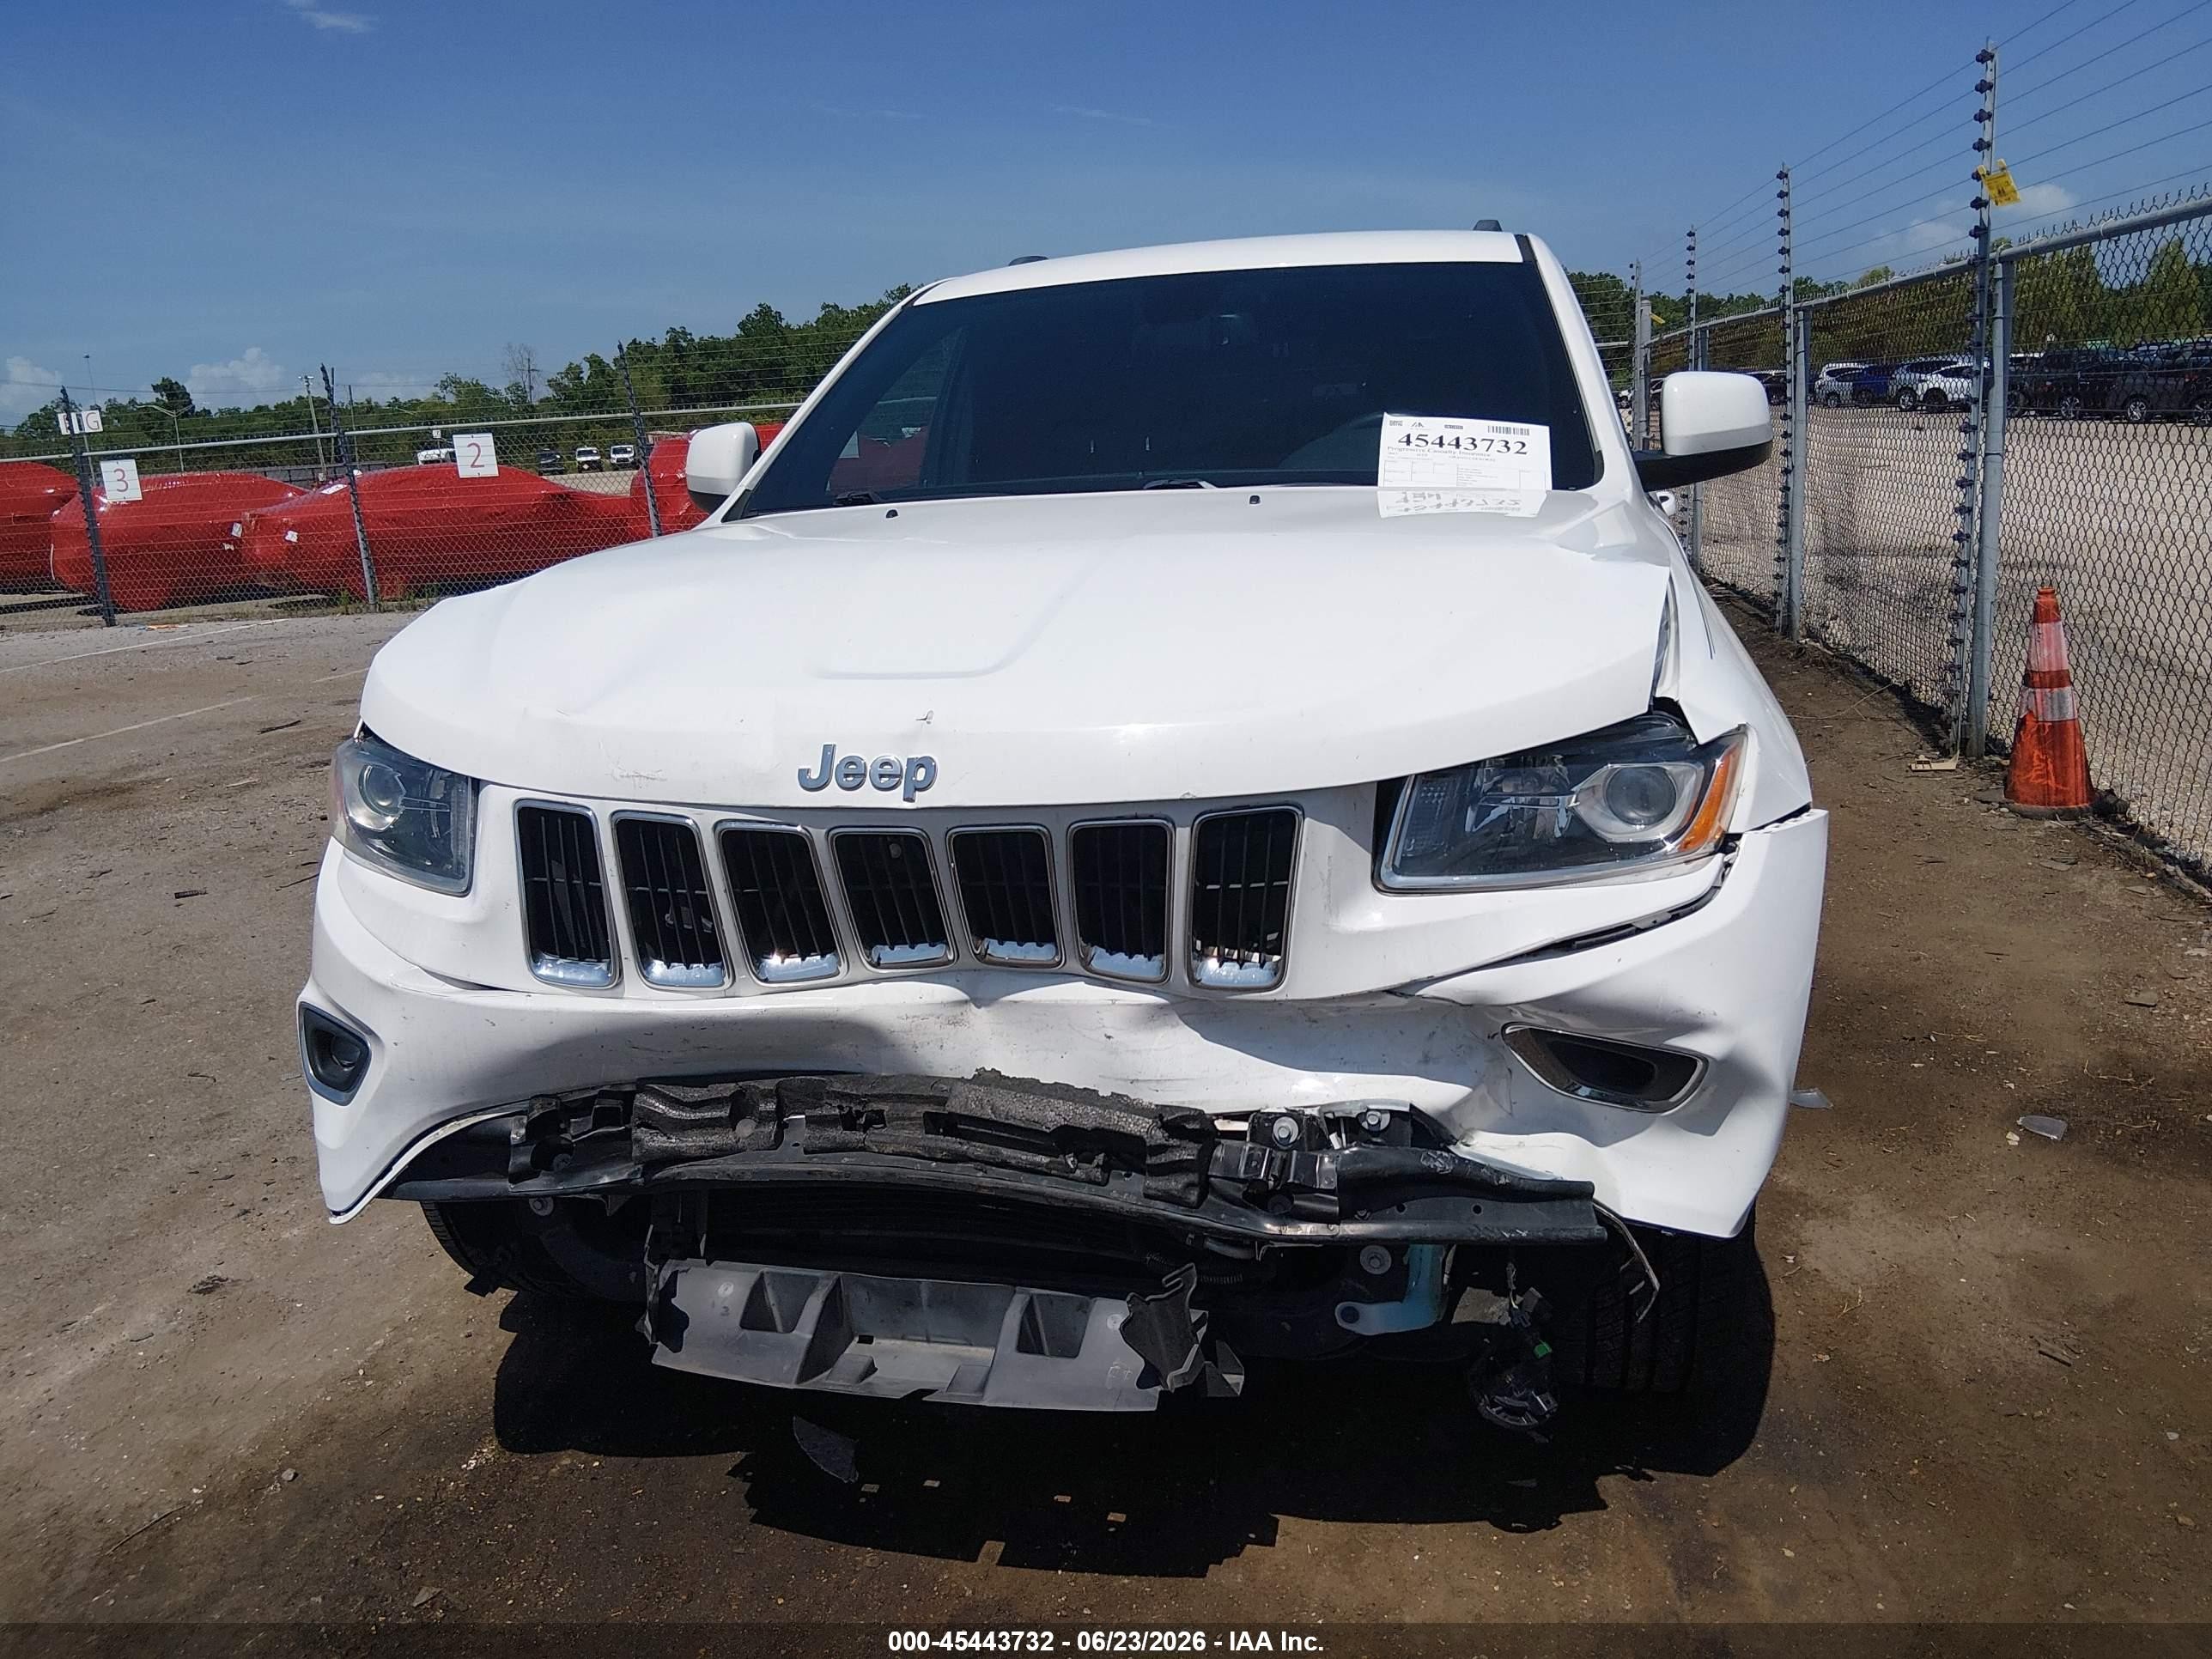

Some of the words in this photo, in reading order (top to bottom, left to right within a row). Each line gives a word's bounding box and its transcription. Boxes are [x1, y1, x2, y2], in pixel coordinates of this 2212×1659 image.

[467, 442, 484, 468] 2
[1398, 433, 1528, 455] 45443732
[113, 467, 129, 493] 3
[798, 743, 939, 803] Jeep
